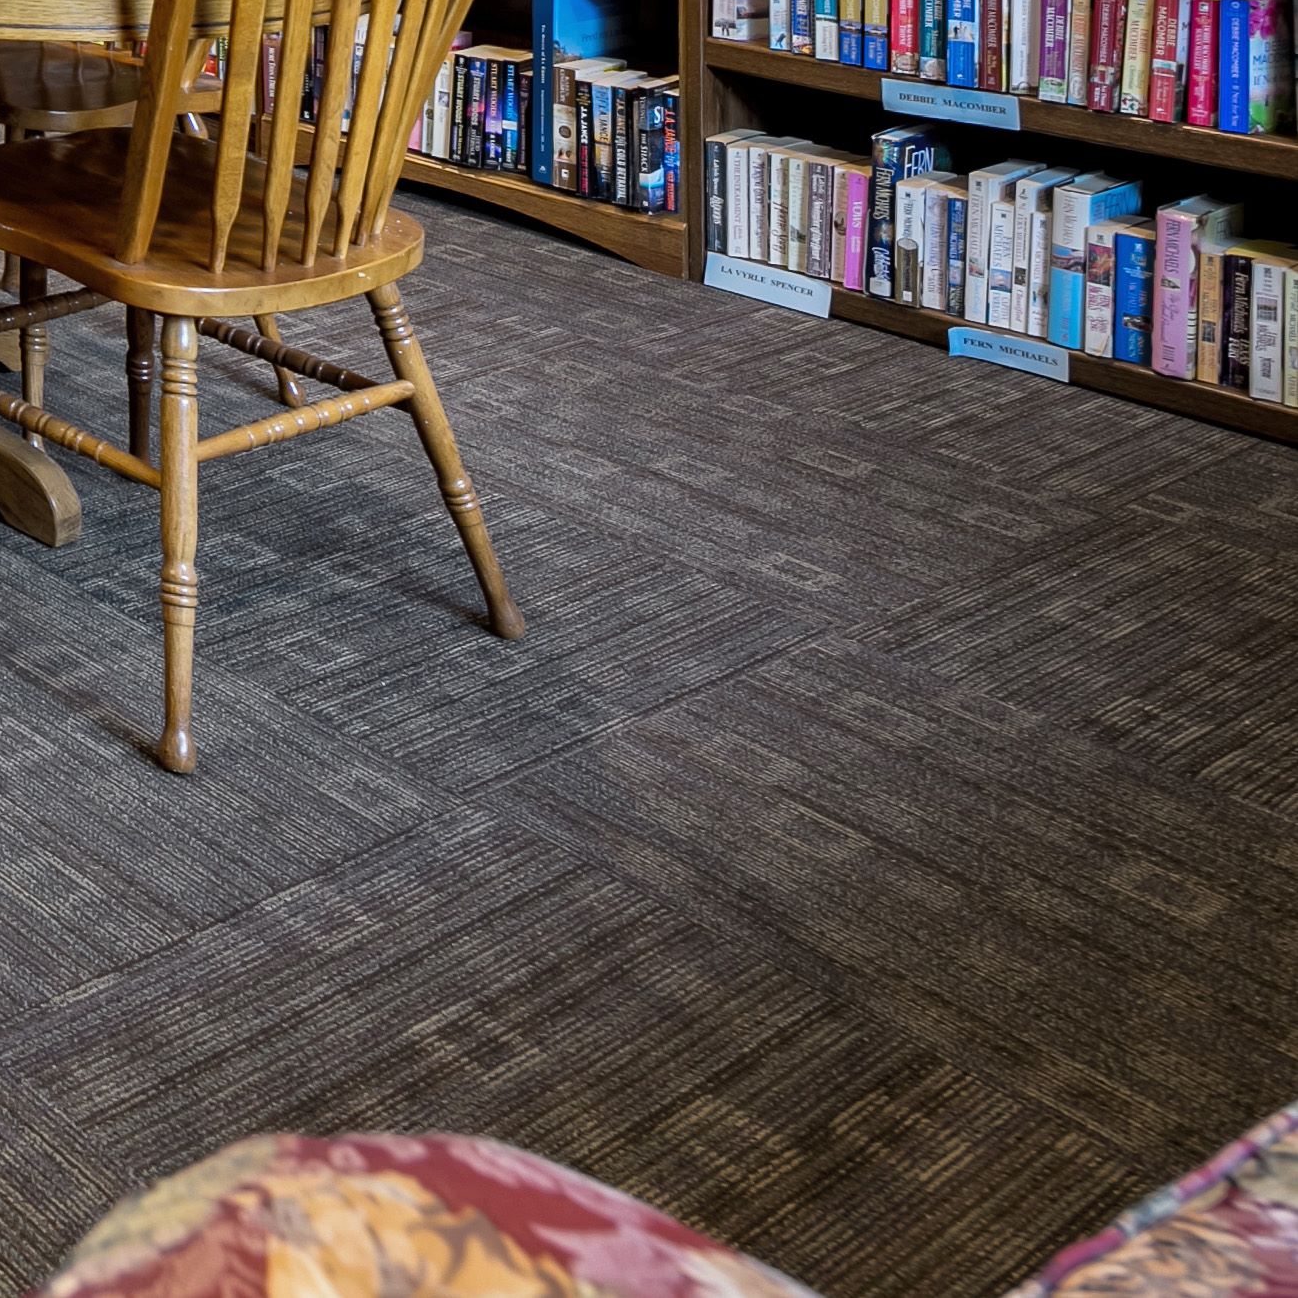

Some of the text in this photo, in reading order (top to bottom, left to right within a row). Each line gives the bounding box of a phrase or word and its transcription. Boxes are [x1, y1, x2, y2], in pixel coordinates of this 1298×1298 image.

[987, 11, 996, 47] MACOMBER
[1045, 7, 1054, 48] MACOMBER
[1055, 16, 1064, 40] DEBBIE
[1129, 20, 1139, 61] MACOMBER
[1156, 6, 1166, 55] MACOMBER
[1166, 18, 1176, 46] DEBBIE
[471, 102, 480, 126] WOODS
[507, 92, 515, 119] WOODS
[898, 92, 1008, 115] DEBBIE MACOMBER
[617, 113, 625, 134] JANCE
[617, 149, 626, 165] COLD
[904, 144, 935, 180] FERN
[617, 167, 626, 199] BETRAYAL
[873, 167, 894, 220] FERN MICHAELS
[852, 201, 862, 228] VOWS
[992, 225, 1003, 267] MICHAELS
[1003, 237, 1013, 257] FERN
[1164, 219, 1181, 274] FERN MICHAELS
[720, 265, 814, 297] LA VYRLE SPENCER
[1233, 272, 1249, 333] Fern Michaels
[962, 336, 1060, 367] FERN MICHAELS
[1228, 337, 1238, 362] FURY
[1239, 338, 1250, 365] TEXAS
